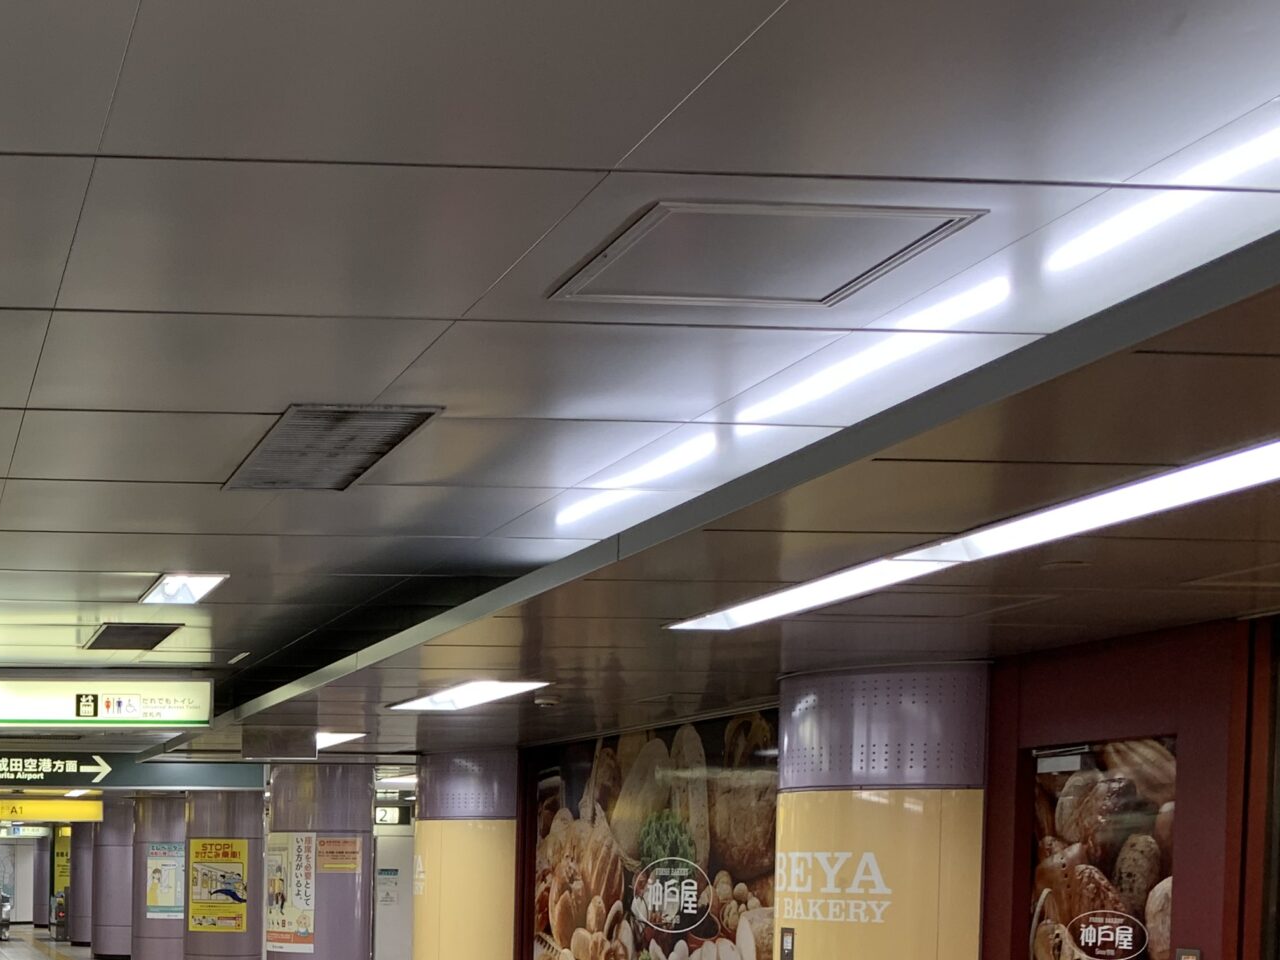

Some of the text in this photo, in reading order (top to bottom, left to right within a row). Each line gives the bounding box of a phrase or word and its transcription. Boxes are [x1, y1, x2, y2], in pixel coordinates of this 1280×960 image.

[16, 772, 44, 780] Airport
[11, 806, 24, 814] A1
[380, 808, 388, 822] 2
[296, 837, 304, 900] いる方がいるよ。
[784, 898, 892, 922] BAKERY
[1080, 924, 1134, 950] 神戸屋
